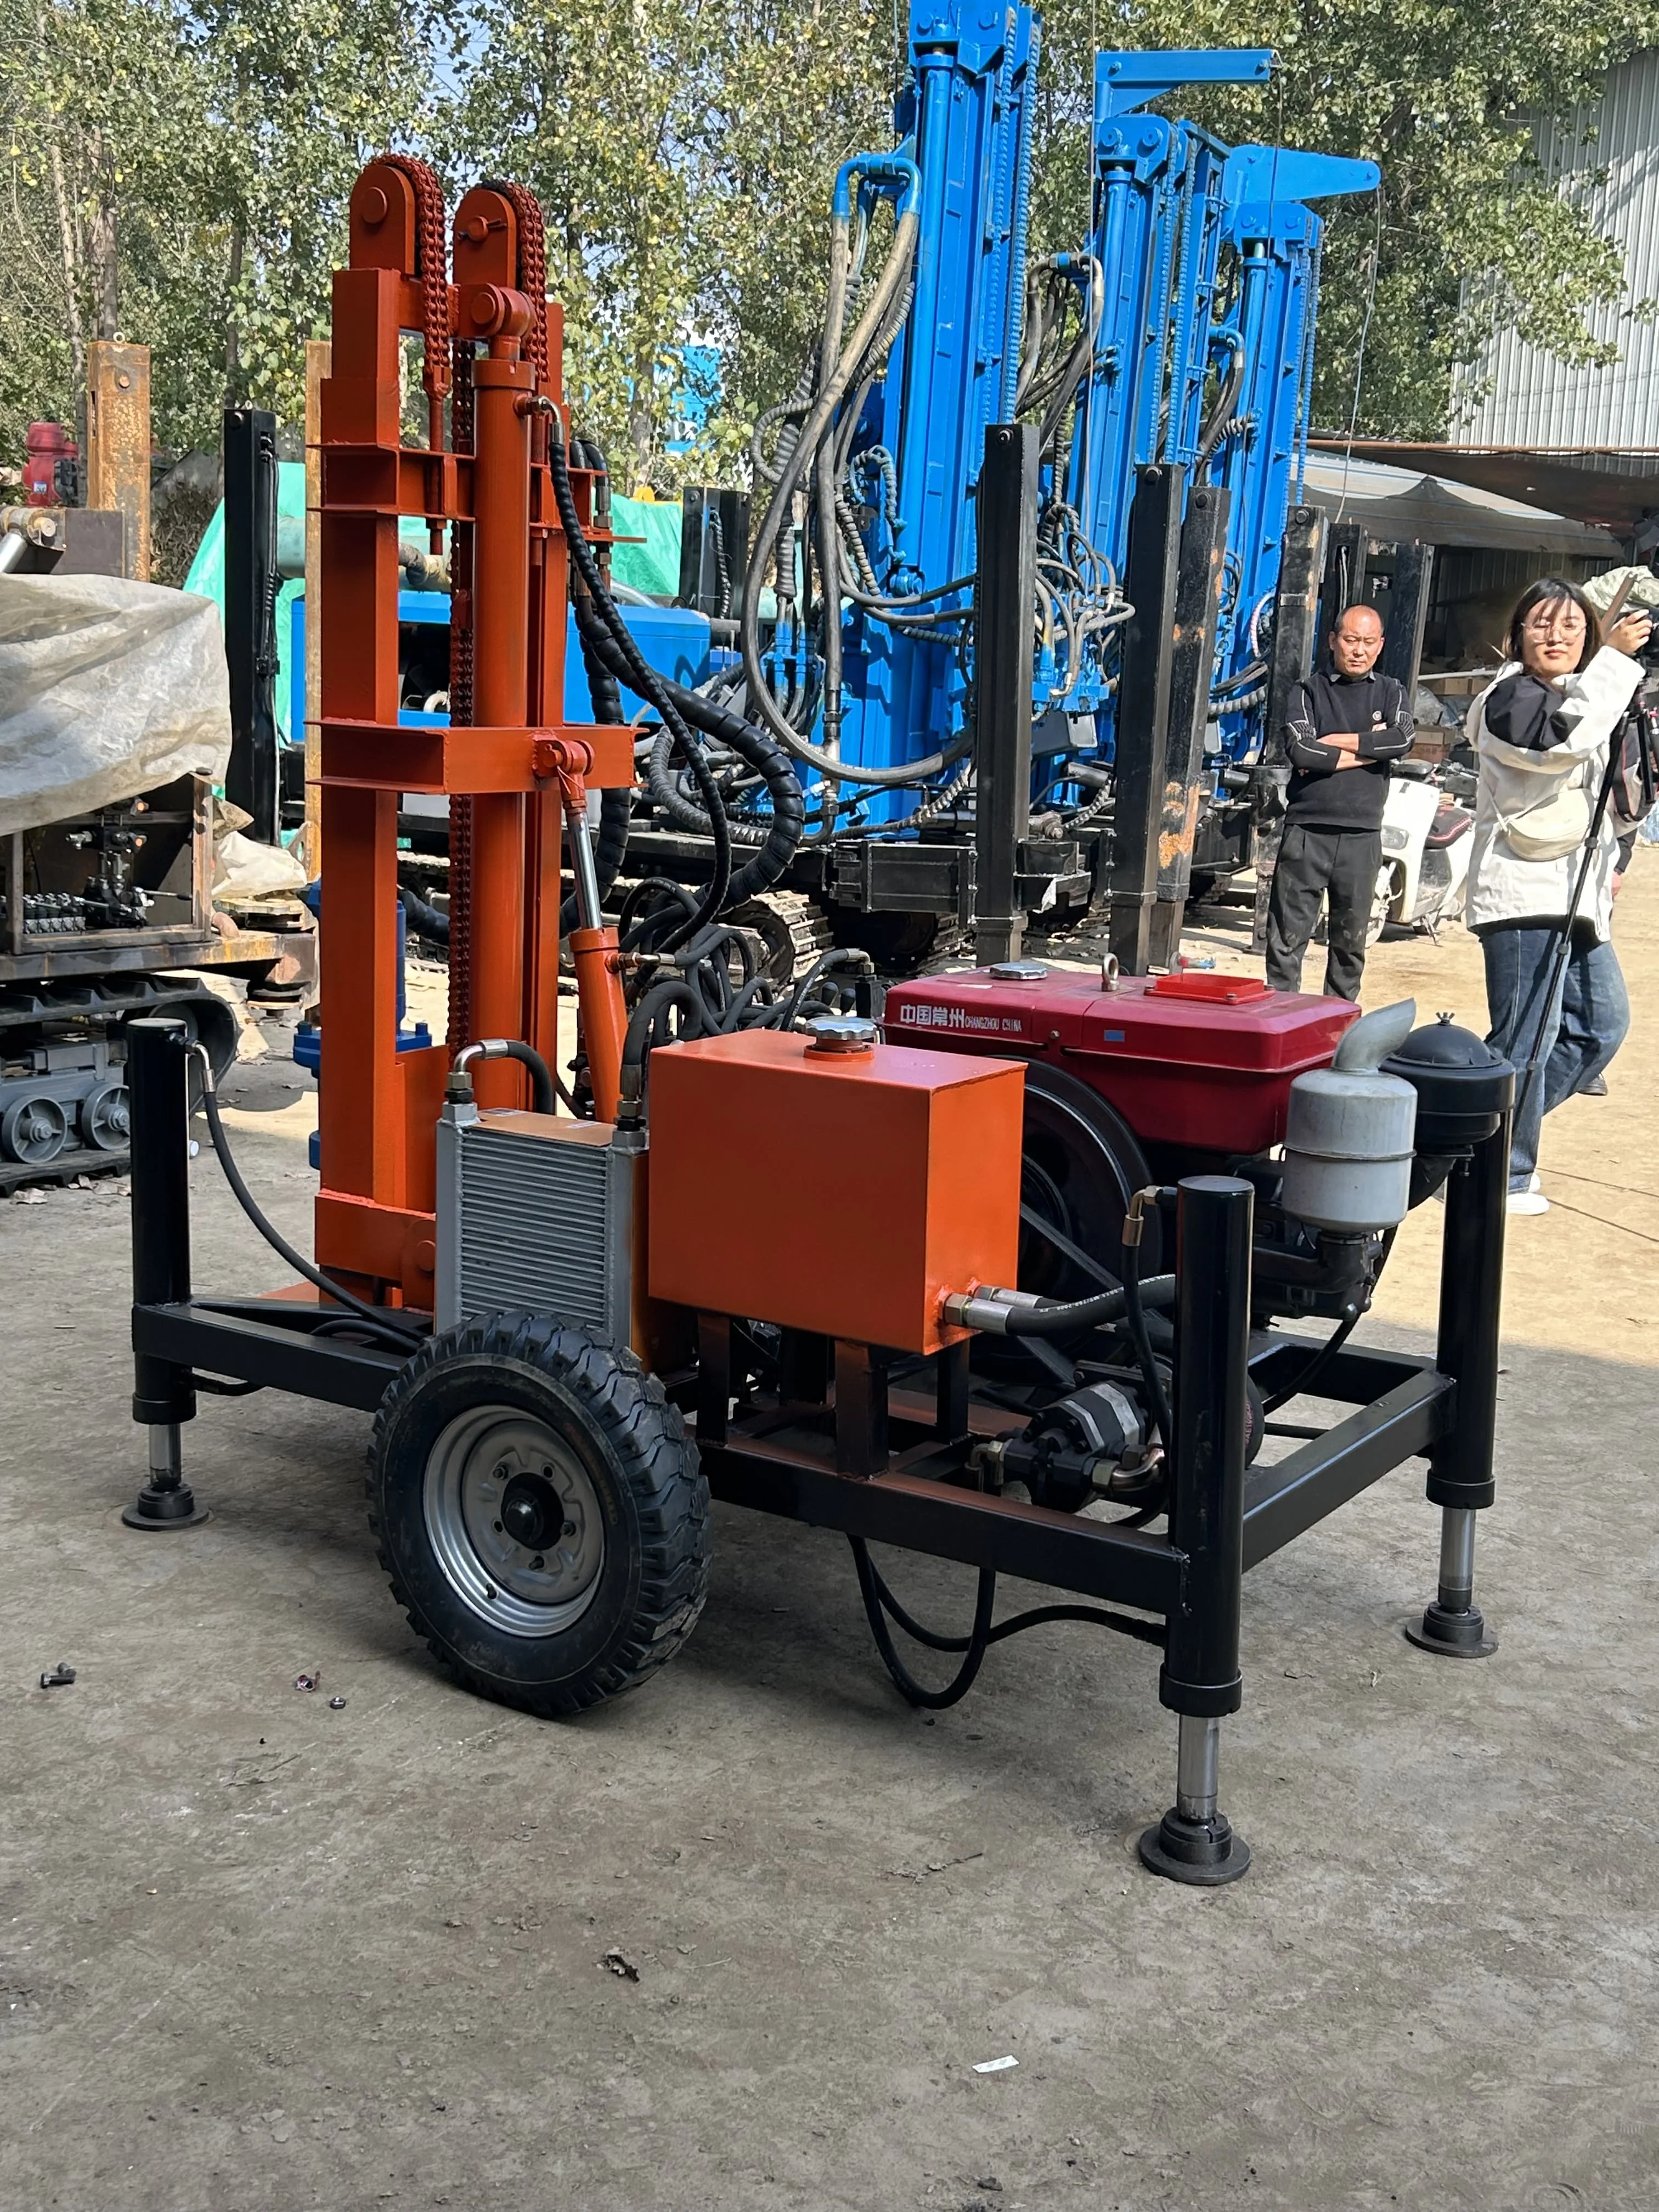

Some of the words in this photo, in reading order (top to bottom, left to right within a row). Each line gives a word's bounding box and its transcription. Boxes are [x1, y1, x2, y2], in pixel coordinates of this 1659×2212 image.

[900, 1005, 965, 1028] 中国常州
[965, 1015, 1000, 1031] CHANGZHOU
[1002, 1018, 1022, 1032] CHINA
